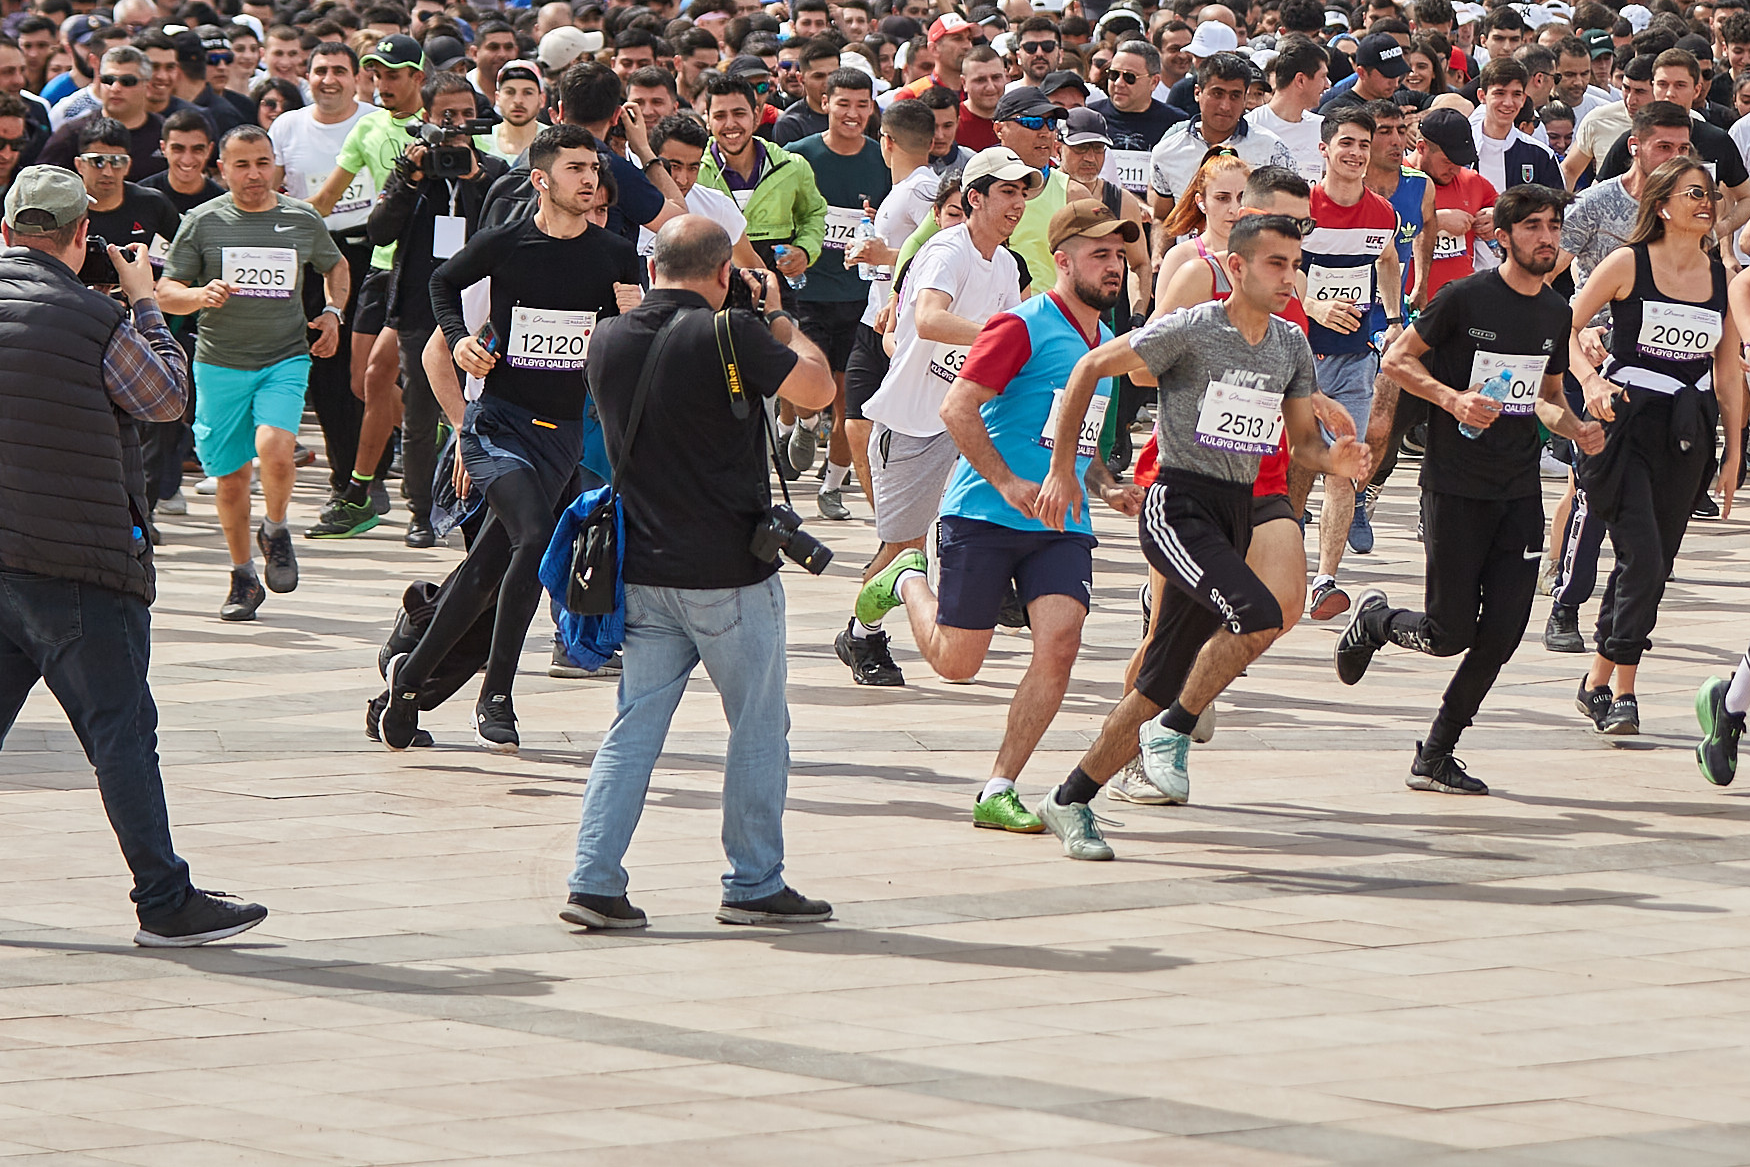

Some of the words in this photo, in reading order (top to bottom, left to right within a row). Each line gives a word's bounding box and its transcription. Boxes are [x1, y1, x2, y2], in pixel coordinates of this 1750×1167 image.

[1366, 236, 1385, 244] UFC
[234, 268, 285, 286] 2205
[521, 333, 584, 355] 12120
[1651, 325, 1709, 349] 2090
[512, 356, 546, 367] KÜLƏYƏ
[727, 363, 741, 393] Nikon
